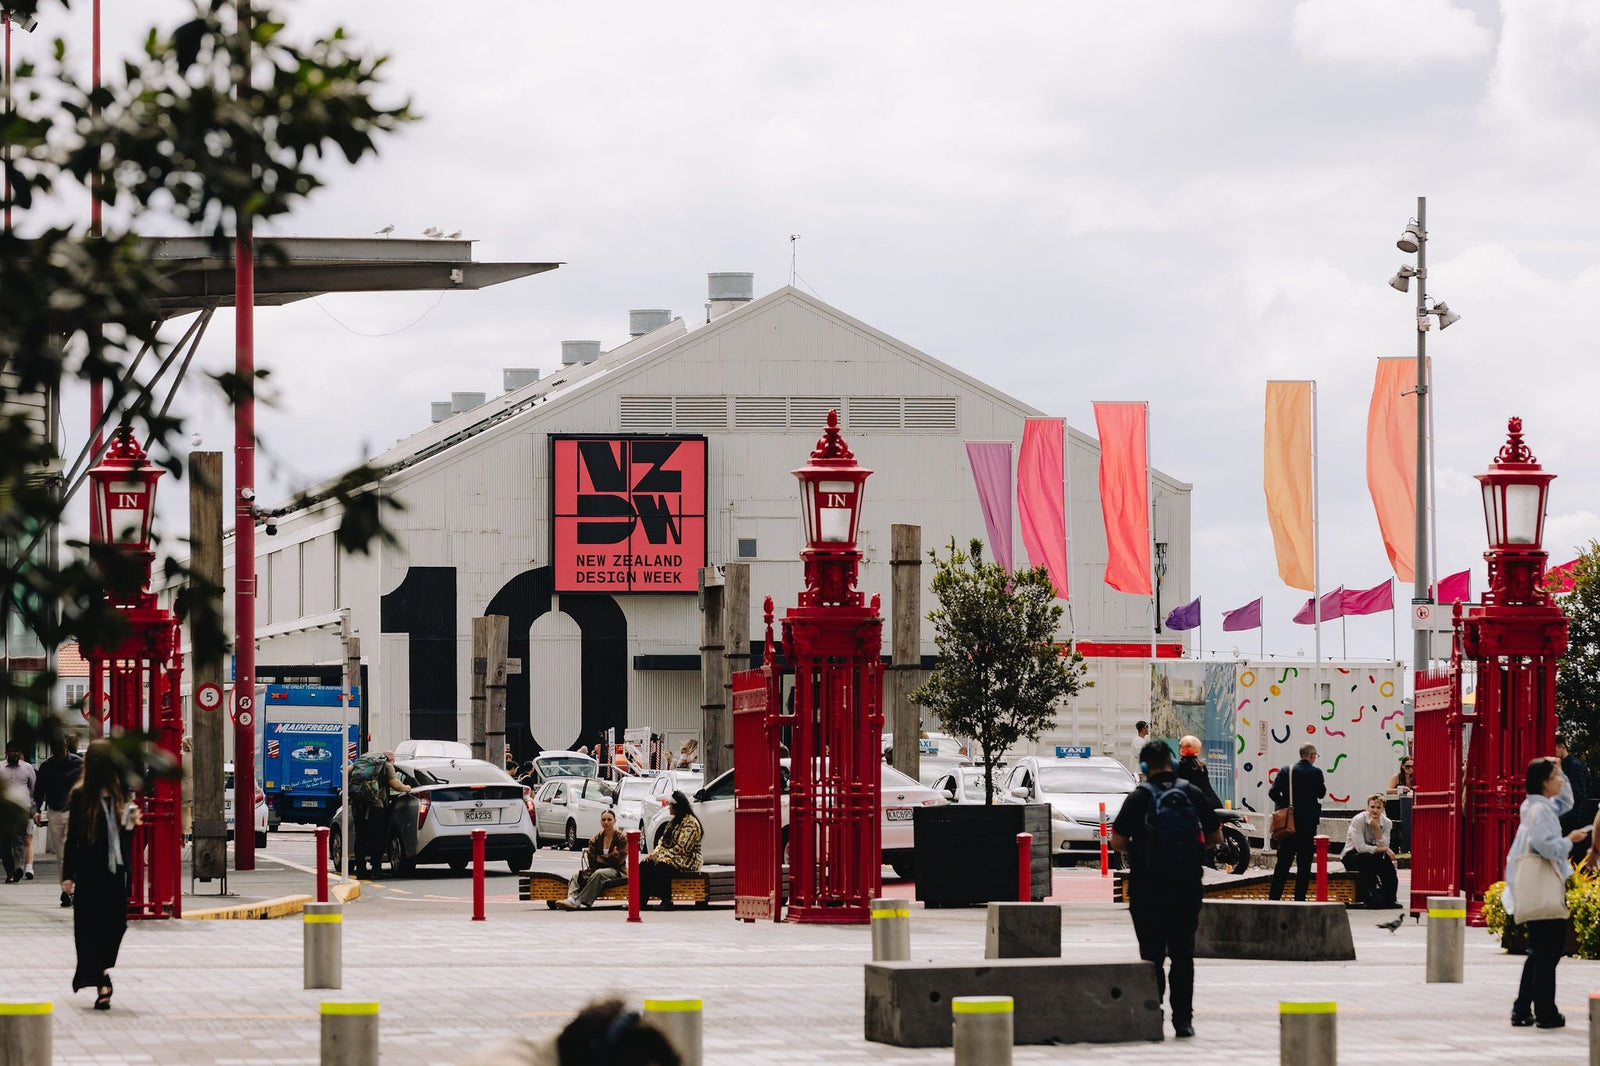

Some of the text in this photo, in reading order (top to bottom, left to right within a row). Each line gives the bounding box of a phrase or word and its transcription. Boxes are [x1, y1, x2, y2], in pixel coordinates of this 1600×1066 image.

[577, 441, 683, 492] NZ
[118, 494, 138, 508] IN
[828, 494, 846, 507] IN
[577, 494, 682, 544] DW
[576, 555, 683, 567] NEW ZEALAND
[576, 571, 682, 583] DESIGN WEEK
[381, 565, 628, 765] 10
[206, 692, 213, 702] 5
[919, 740, 932, 748] AXI
[465, 810, 492, 820] RCA233
